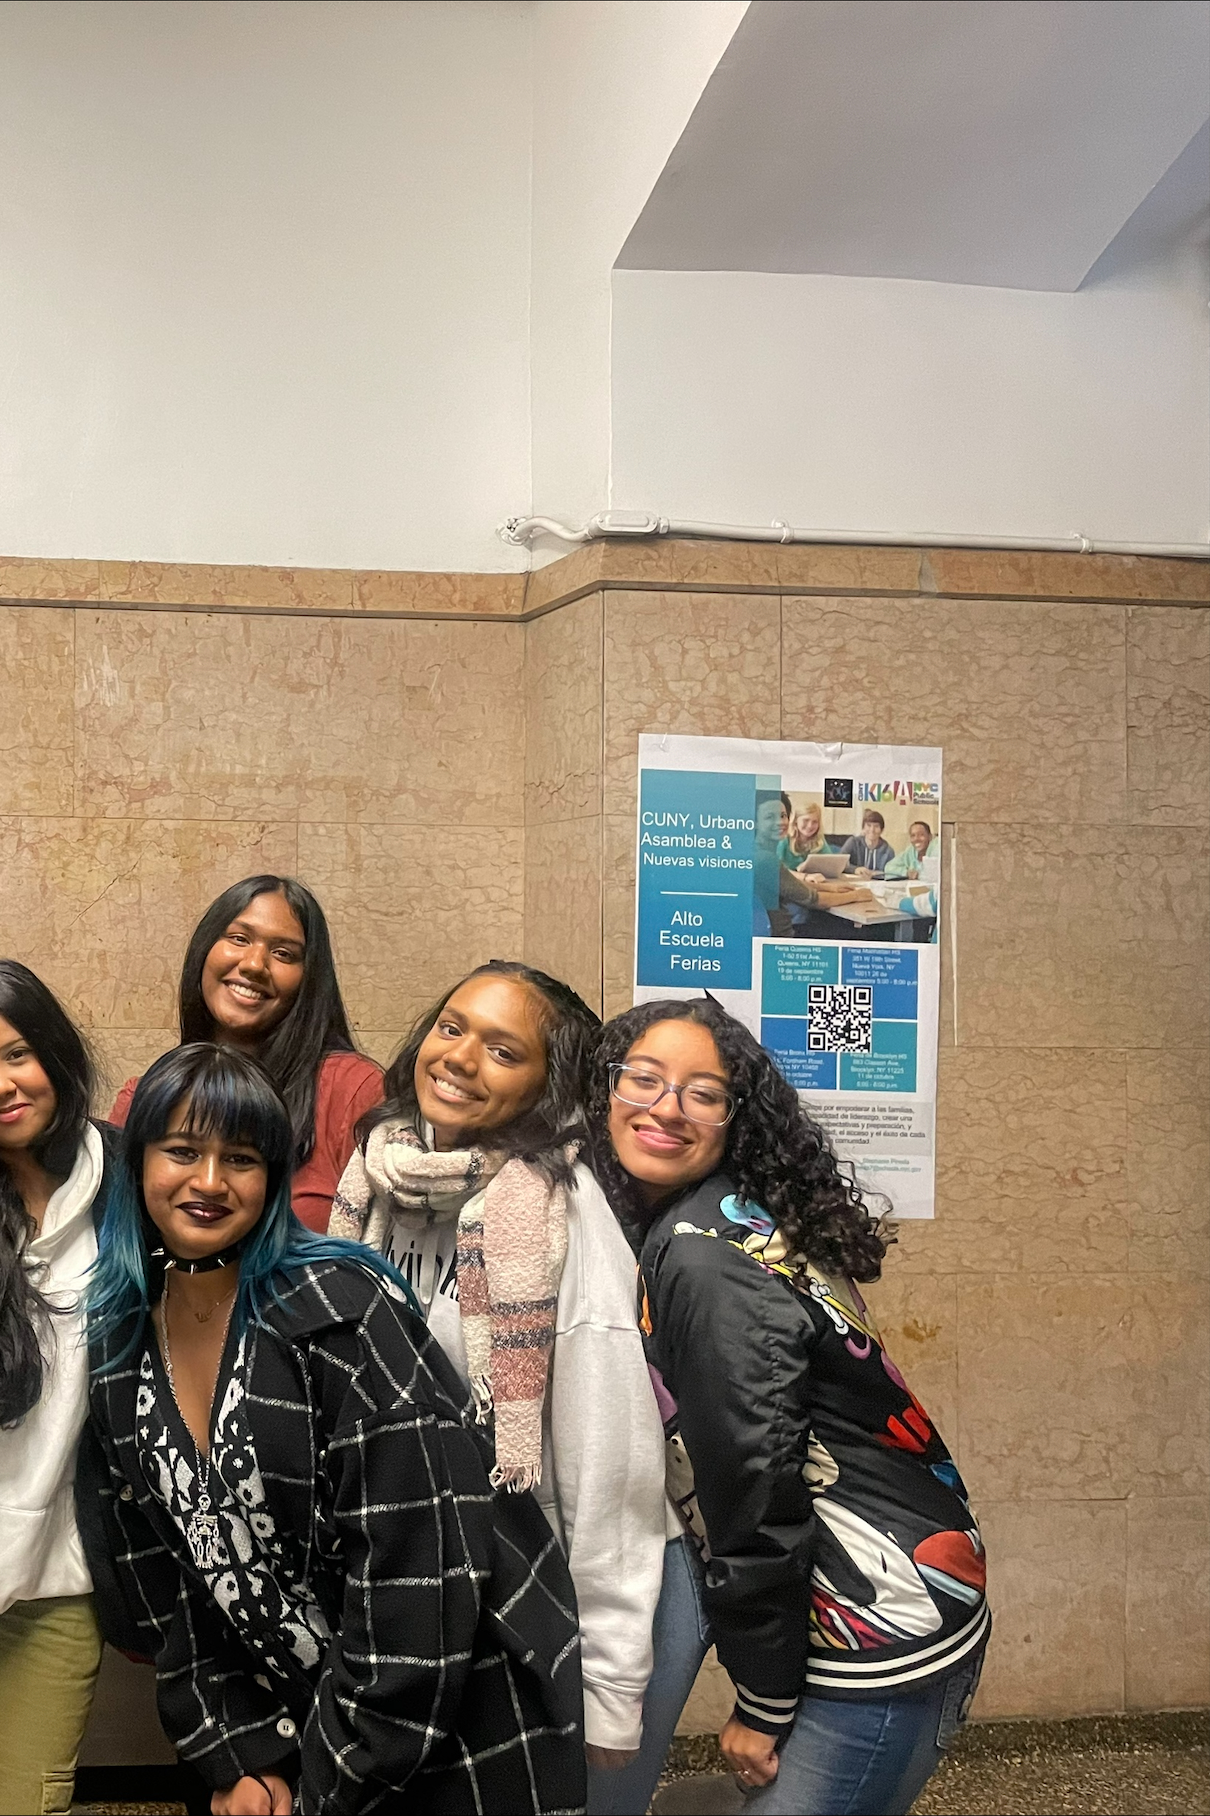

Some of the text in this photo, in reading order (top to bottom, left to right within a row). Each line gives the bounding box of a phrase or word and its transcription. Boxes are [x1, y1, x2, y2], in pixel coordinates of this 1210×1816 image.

[913, 782, 939, 792] NYC
[642, 812, 755, 830] CUNY, Urbano
[641, 832, 732, 849] Asamblea &
[643, 852, 753, 870] Nuevas visiones
[671, 911, 703, 926] Alto
[659, 930, 724, 948] Escuela
[670, 954, 721, 971] Ferias
